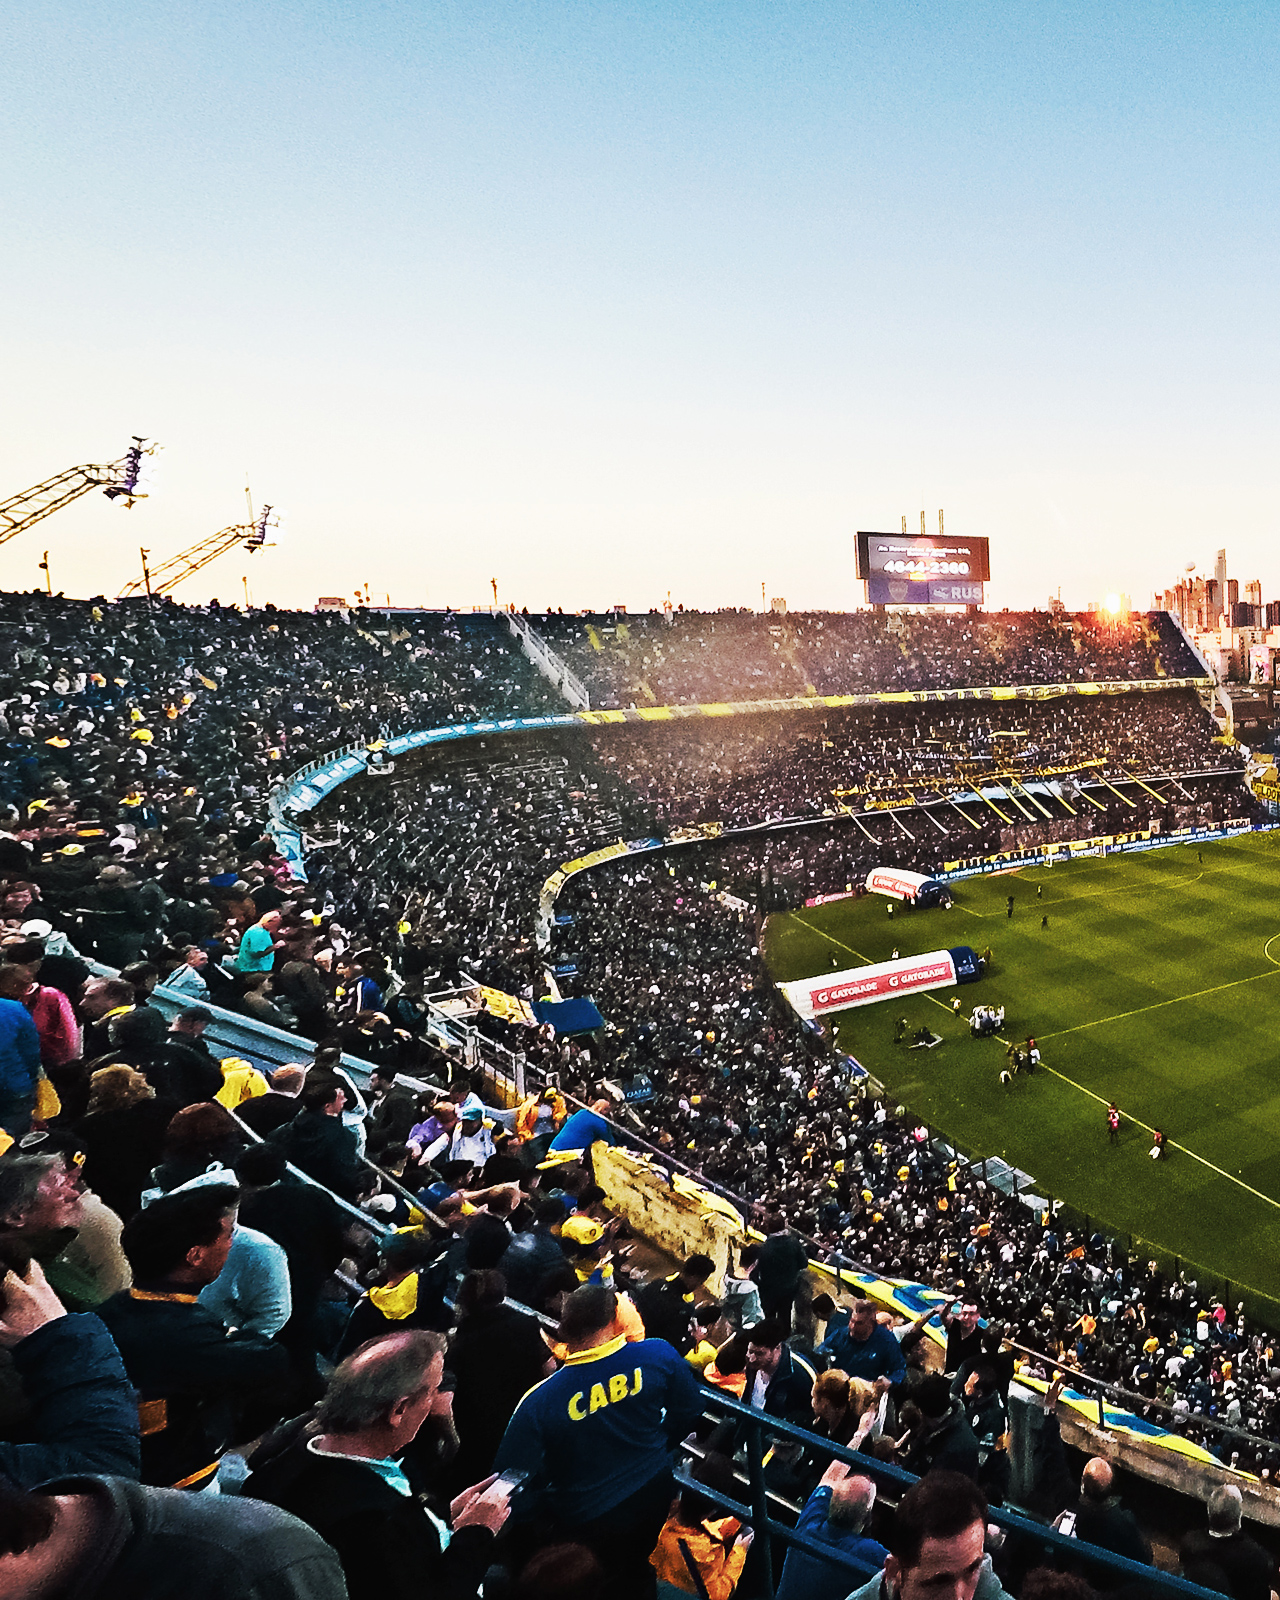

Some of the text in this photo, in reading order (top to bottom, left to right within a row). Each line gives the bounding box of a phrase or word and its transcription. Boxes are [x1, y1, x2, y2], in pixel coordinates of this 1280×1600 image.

[951, 587, 982, 599] RUS
[818, 992, 829, 1004] G
[830, 981, 878, 1000] GATORADE
[888, 976, 899, 987] G
[901, 966, 946, 984] GATORADE
[627, 1086, 651, 1099] QATAR
[567, 1367, 644, 1421] CABJ
